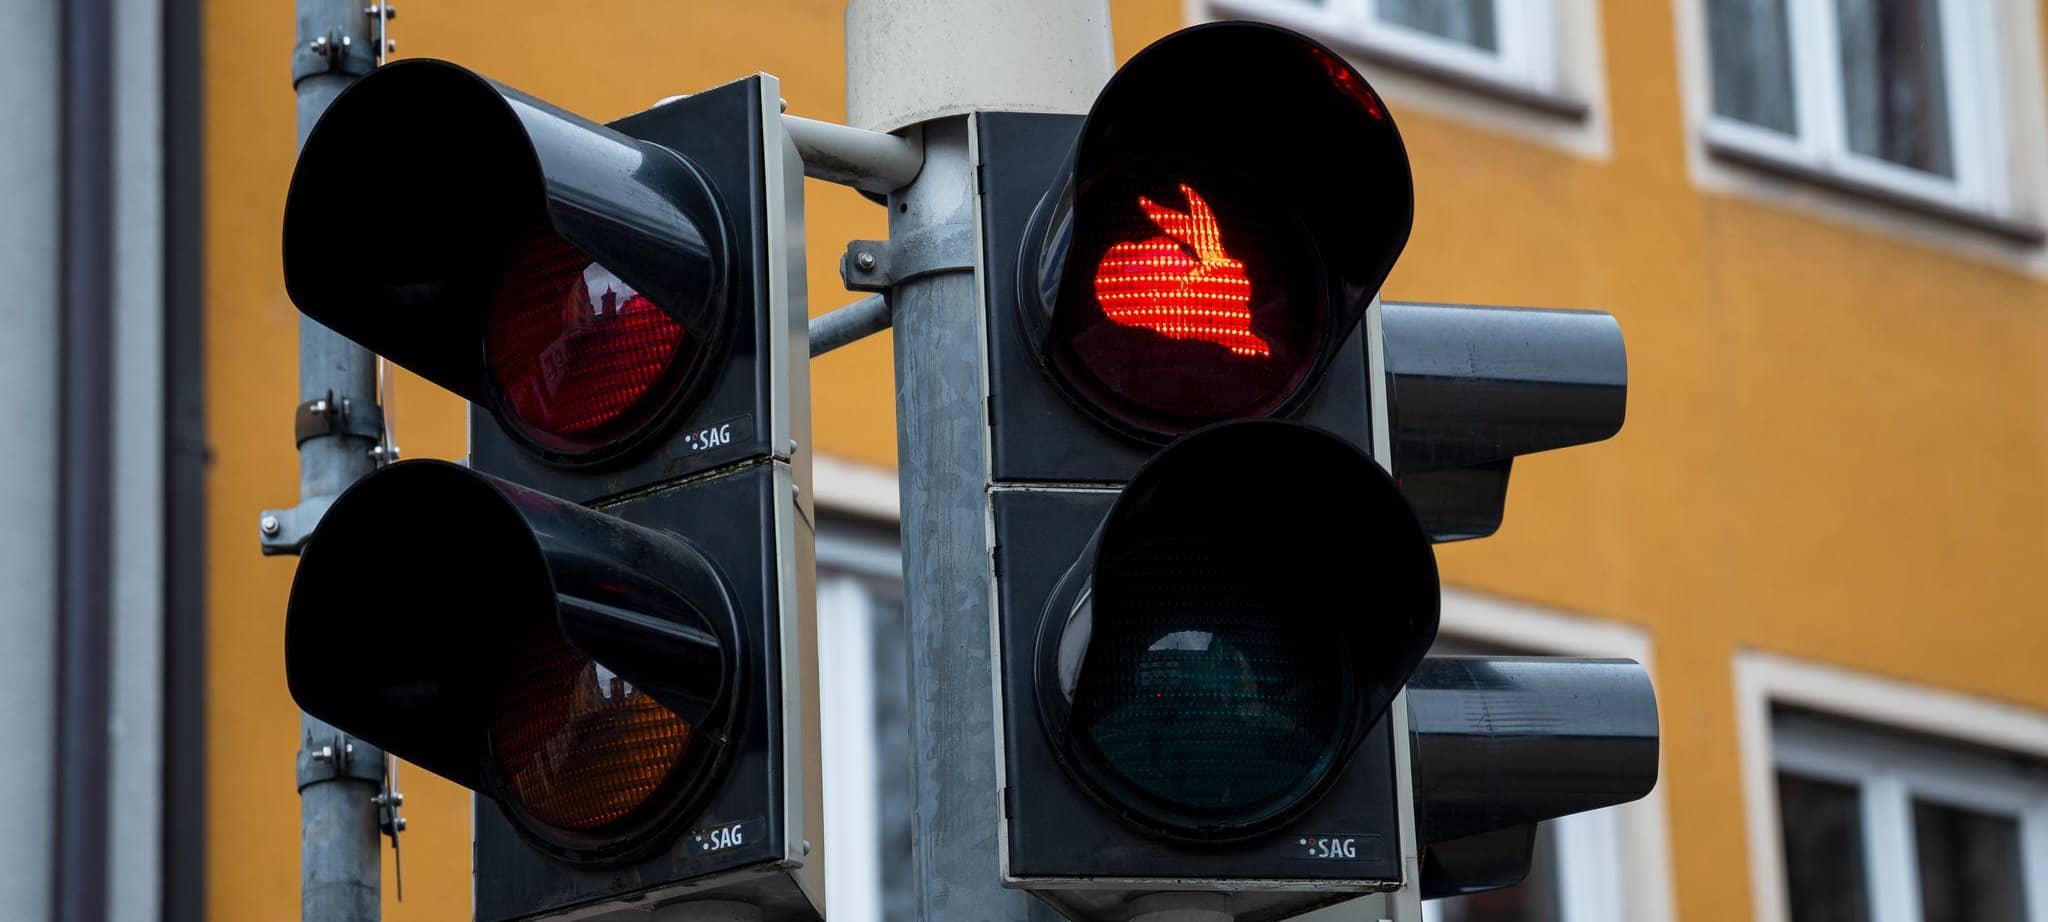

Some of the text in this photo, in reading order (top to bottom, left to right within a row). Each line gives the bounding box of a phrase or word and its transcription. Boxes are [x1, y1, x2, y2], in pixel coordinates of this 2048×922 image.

[700, 424, 730, 450] SAG
[711, 824, 742, 850] SAG
[1318, 838, 1356, 858] SAG
